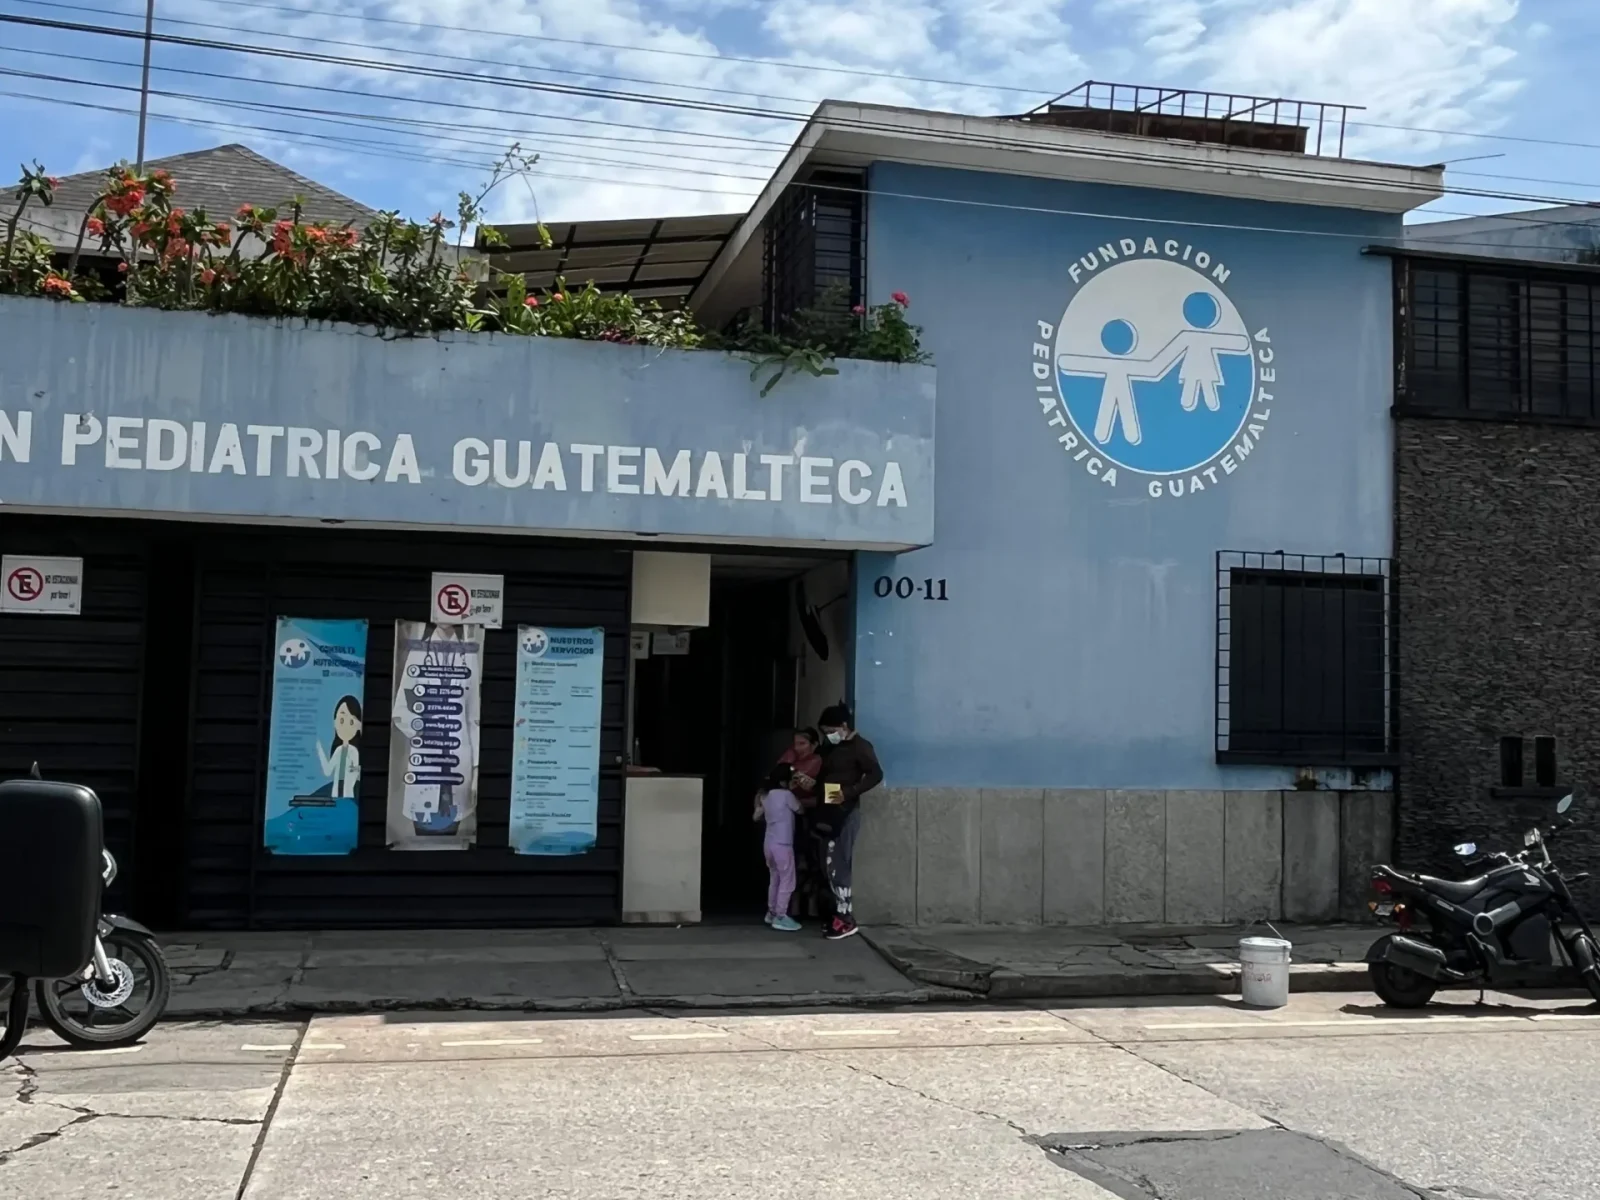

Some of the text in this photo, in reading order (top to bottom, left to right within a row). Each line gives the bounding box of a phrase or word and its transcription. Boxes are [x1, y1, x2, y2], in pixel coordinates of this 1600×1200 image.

[1067, 236, 1231, 284] FUNDACION
[1032, 319, 1277, 498] PEDIATRICA GUATEMALTECA
[60, 413, 422, 484] PEDIATRICA
[452, 436, 908, 507] GUATEMALTECA
[873, 575, 949, 601] 00-11
[550, 636, 594, 645] NUESTROS
[550, 646, 594, 655] SERVICIOS
